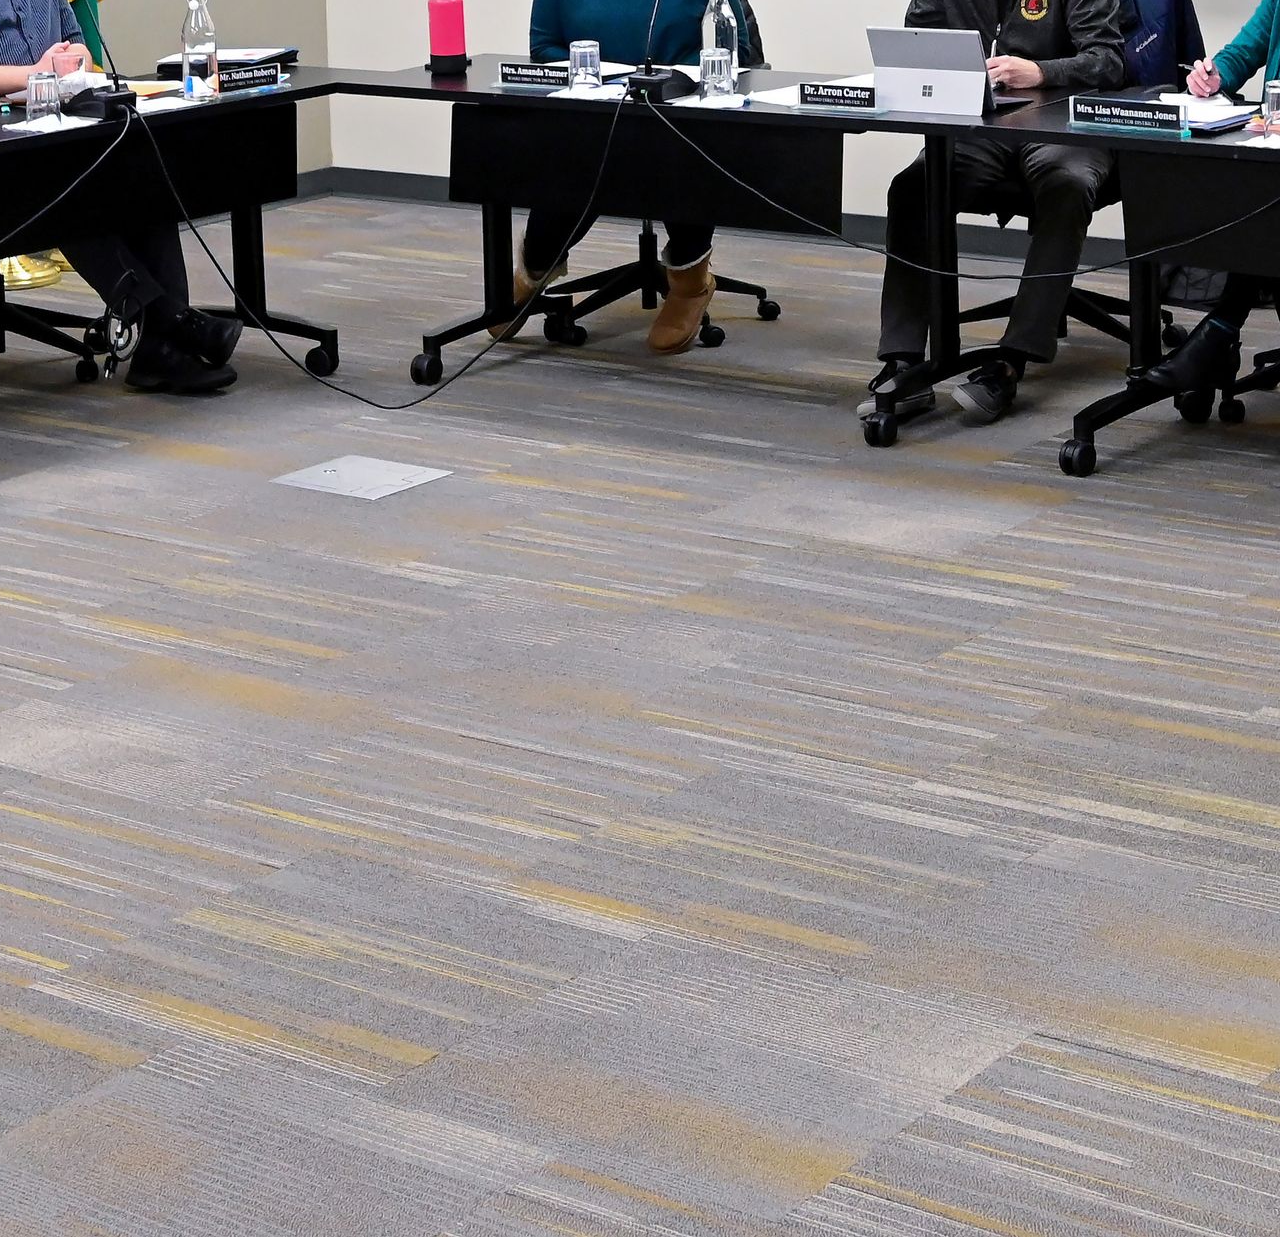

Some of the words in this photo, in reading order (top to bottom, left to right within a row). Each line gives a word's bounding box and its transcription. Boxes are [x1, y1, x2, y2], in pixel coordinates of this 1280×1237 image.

[220, 73, 231, 82] Mr.
[231, 69, 253, 80] Nathan
[253, 67, 276, 77] Roberts
[502, 66, 516, 74] Mrs.
[518, 67, 543, 76] Amanda
[804, 85, 817, 95] Dr.
[818, 86, 842, 97] Arron
[843, 88, 870, 98] Carter
[1076, 104, 1094, 113] Mrs.
[1095, 105, 1111, 115] Lisa
[1153, 111, 1177, 121] Jones
